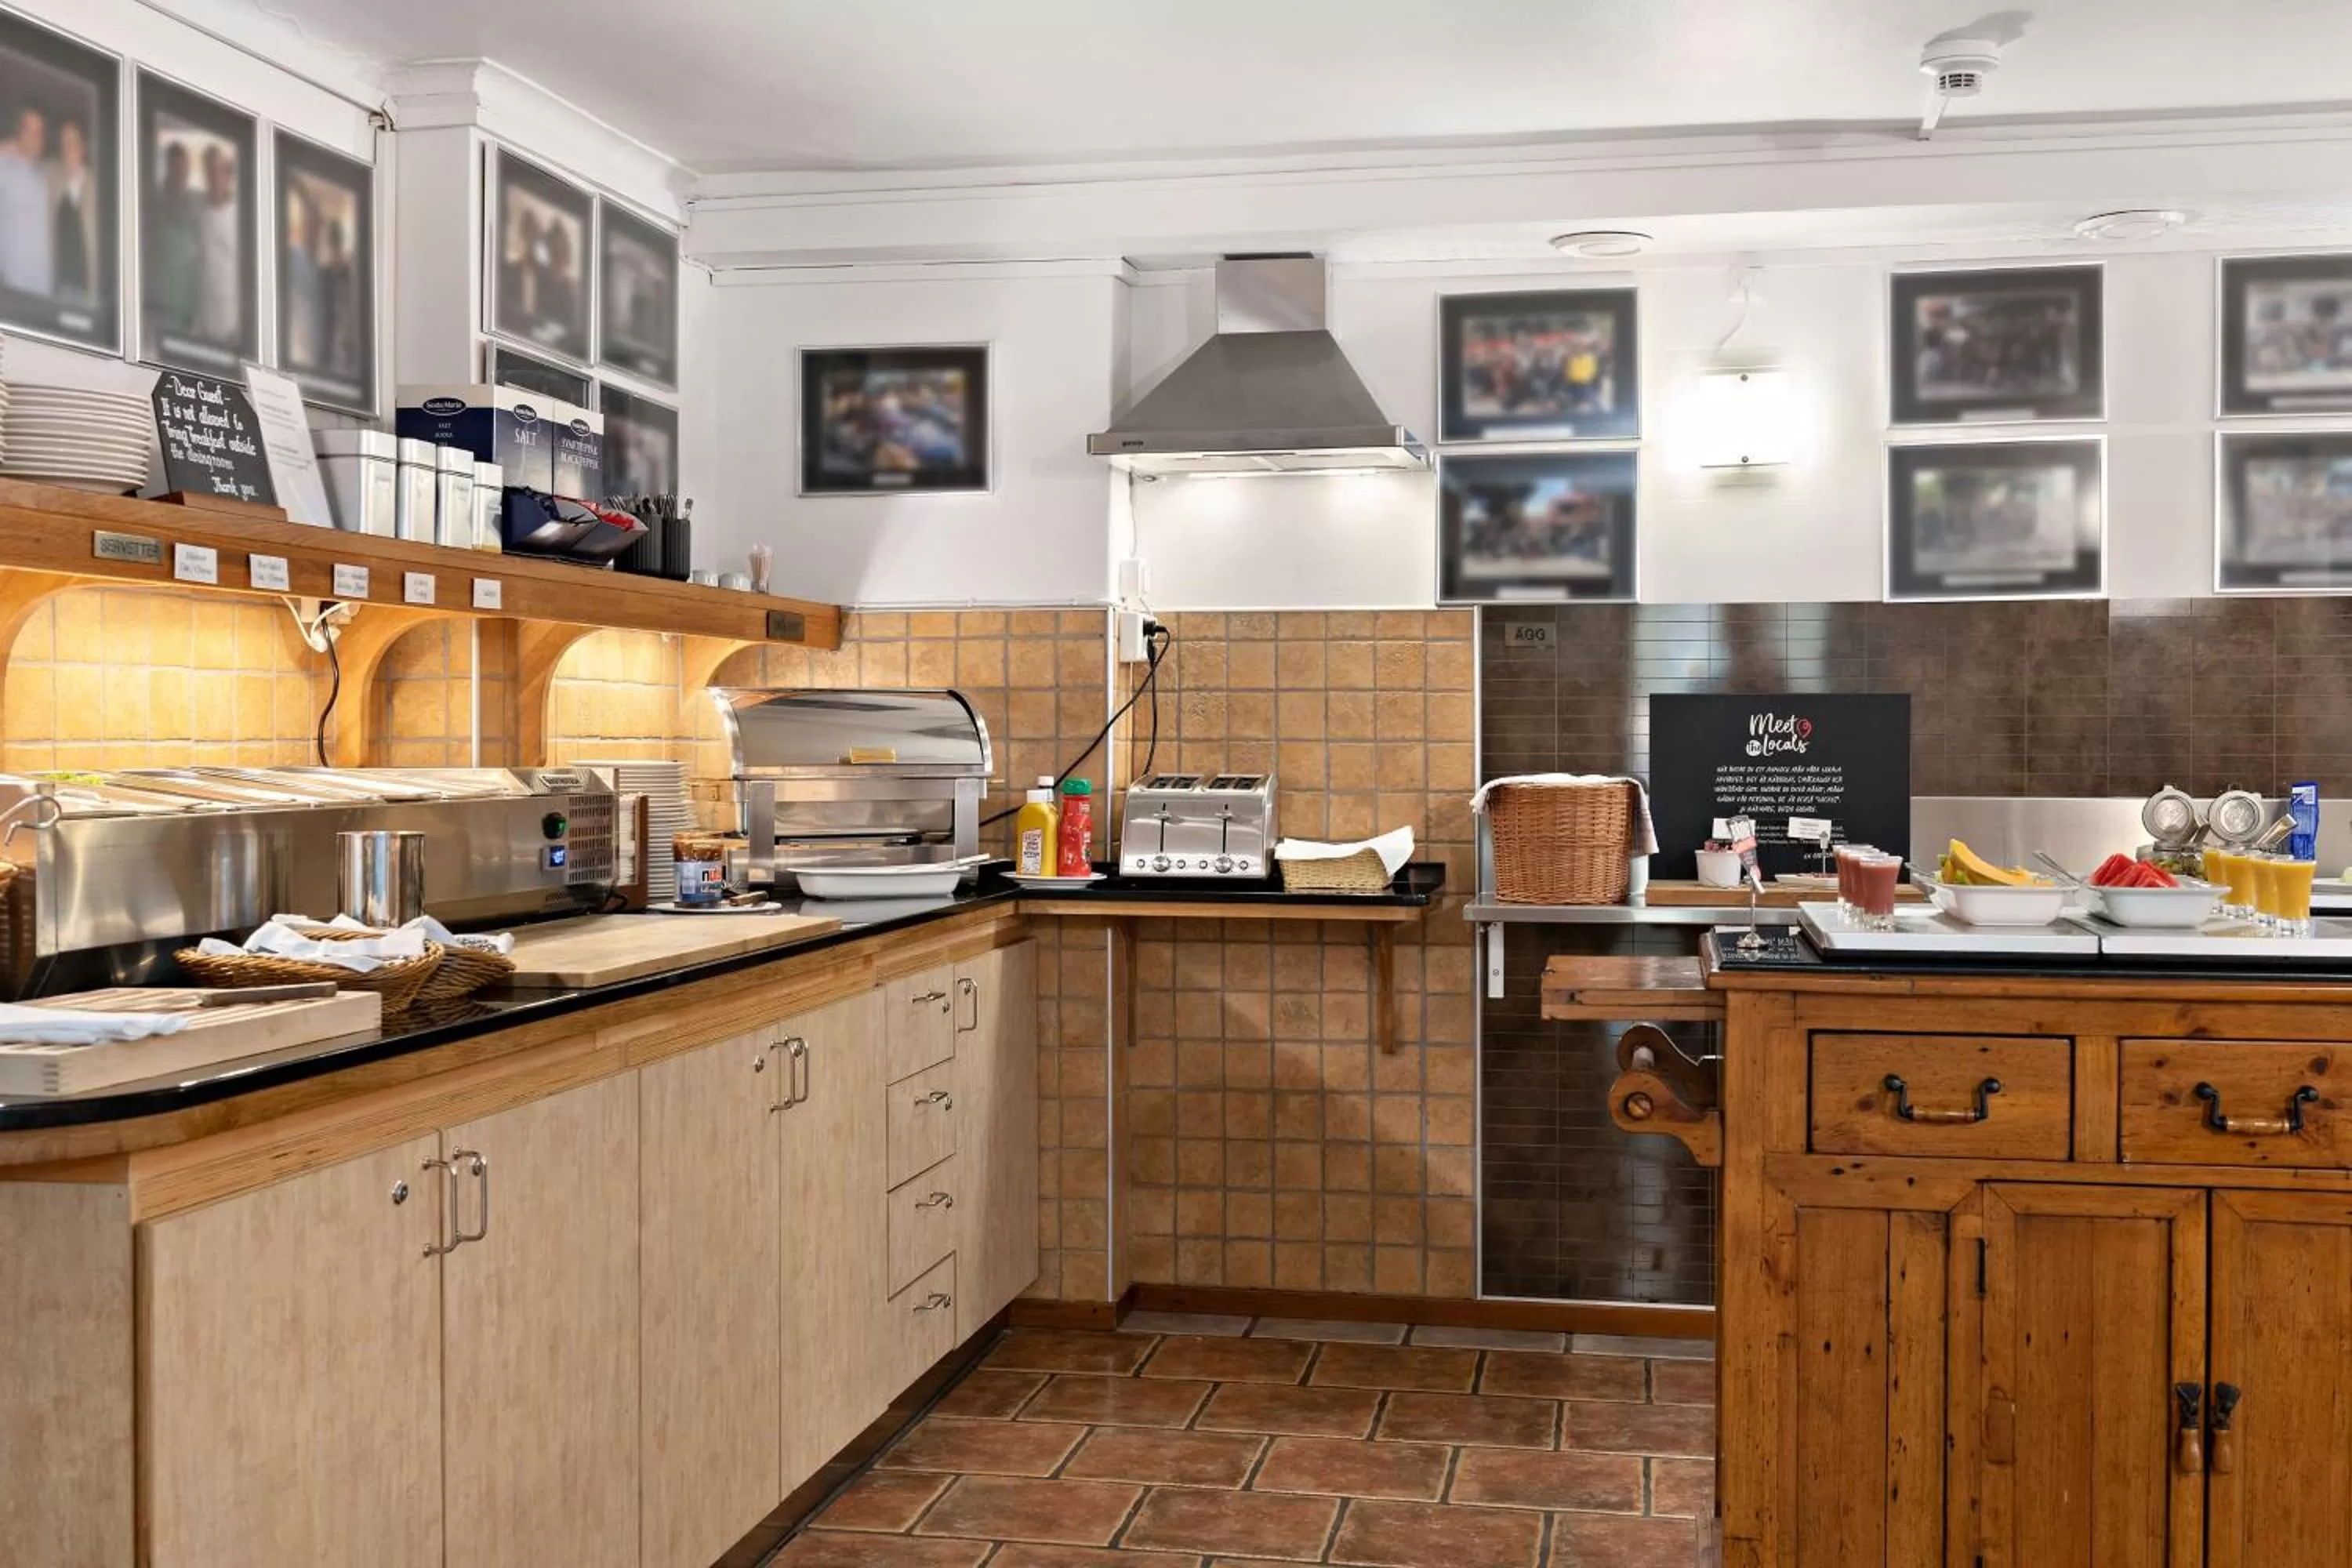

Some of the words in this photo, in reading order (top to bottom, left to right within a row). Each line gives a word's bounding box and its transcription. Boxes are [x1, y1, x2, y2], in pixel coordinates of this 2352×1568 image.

[172, 402, 181, 418] is
[182, 404, 196, 422] not
[199, 405, 230, 429] allowed
[233, 413, 244, 430] to
[184, 424, 227, 453] breakfast
[228, 435, 257, 456] outside
[514, 427, 538, 446] SALT
[170, 443, 185, 459] the
[212, 477, 238, 495] Thank
[1749, 713, 1798, 736] Meet
[1762, 734, 1809, 757] Locals
